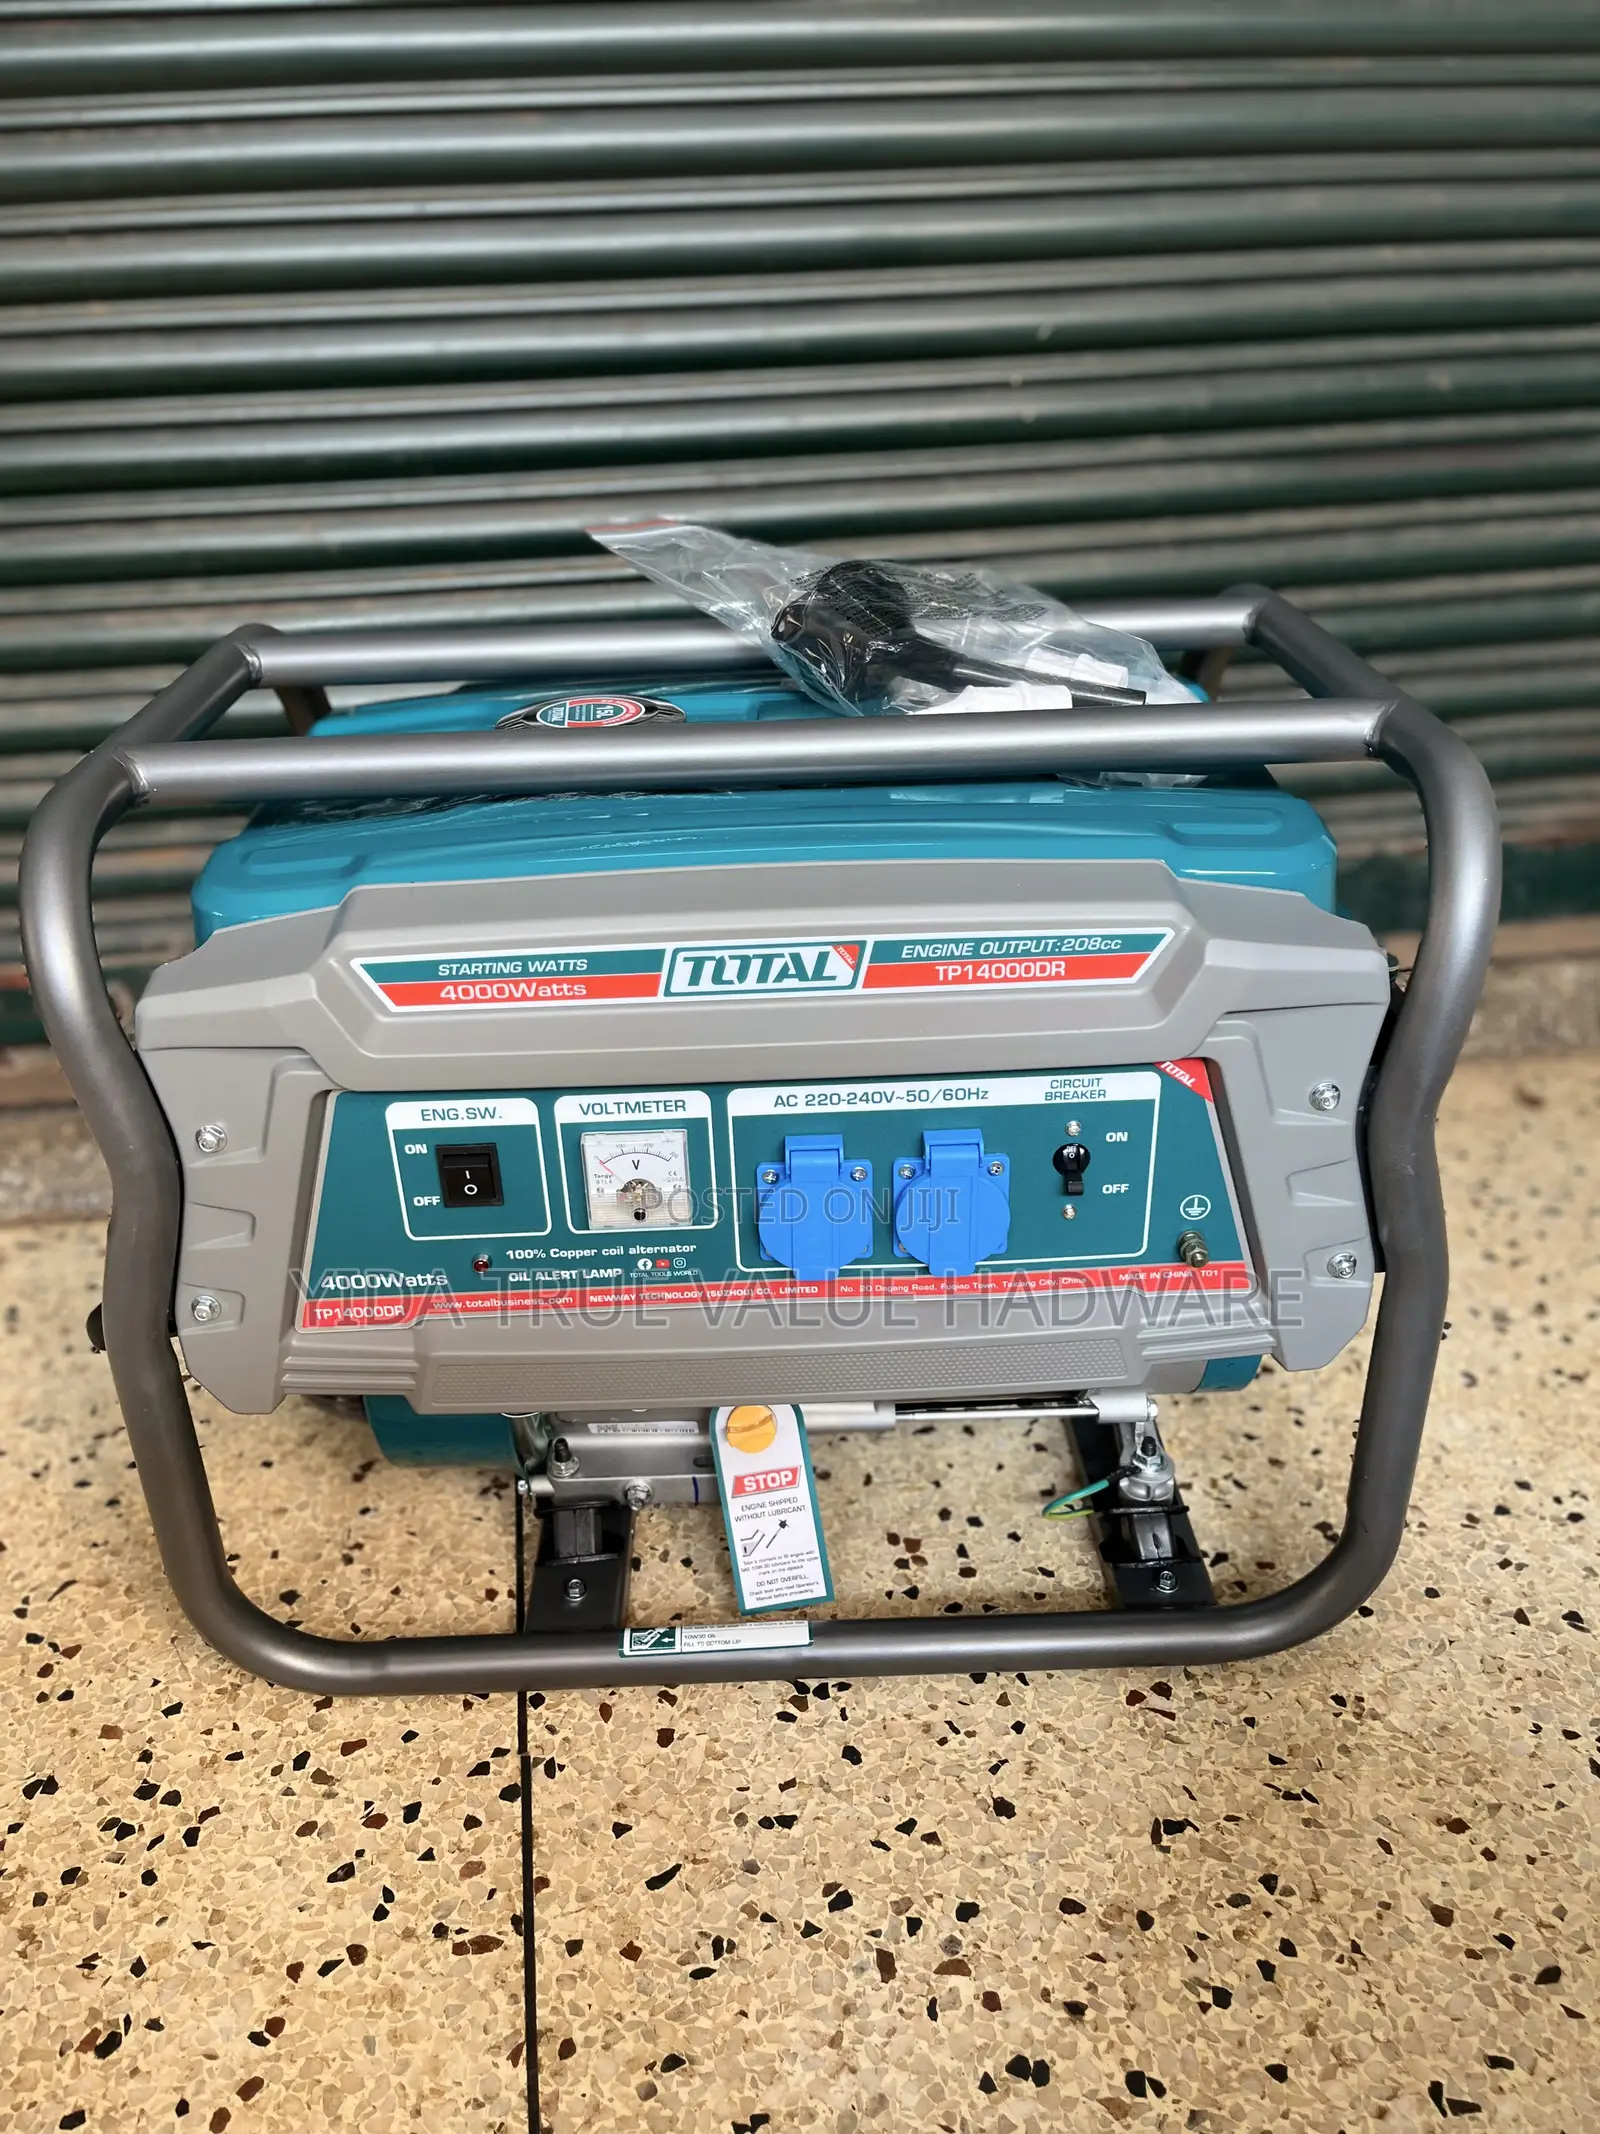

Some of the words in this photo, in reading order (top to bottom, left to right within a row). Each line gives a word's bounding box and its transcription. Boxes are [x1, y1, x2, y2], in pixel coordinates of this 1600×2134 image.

[901, 941, 974, 959] ENGINE
[980, 936, 1122, 956] OUTPUT:208cc
[438, 960, 523, 977] STARTING
[528, 958, 588, 972] WATTS
[682, 949, 837, 988] TOTAL
[935, 961, 1066, 982] TP14000DR
[440, 982, 588, 1001] 4000Watts
[1160, 1060, 1197, 1088] TOTAL
[1050, 1077, 1104, 1090] CIRCUIT
[773, 1093, 799, 1109] AC
[1044, 1089, 1107, 1101] BREAKER
[420, 1106, 503, 1122] ENG.SW.
[579, 1099, 687, 1116] VOLTMETER
[1105, 1131, 1129, 1142] ON
[404, 1143, 428, 1155] ON
[1066, 1145, 1077, 1153] OFF
[631, 1159, 640, 1170] V
[1101, 1183, 1130, 1194] OFF
[413, 1195, 441, 1207] OFF
[505, 1249, 547, 1260] 100%
[550, 1248, 597, 1260] Copper
[601, 1245, 624, 1256] coil
[628, 1244, 697, 1255] alternator
[508, 1271, 531, 1282] OIL
[535, 1269, 578, 1281] ALERT
[582, 1268, 623, 1279] LAMP
[651, 1270, 672, 1278] TOOLS
[673, 1268, 699, 1277] WORLD
[1118, 1272, 1147, 1281] MADE
[1150, 1271, 1161, 1280] IN
[1162, 1270, 1194, 1280] CHINA
[321, 1272, 448, 1291] 4000Watts
[840, 1284, 856, 1294] No.
[859, 1283, 873, 1293] 20
[940, 1281, 970, 1293] Fuqiao
[589, 1294, 636, 1304] NEWWAY
[639, 1290, 704, 1301] TECHNOLOGY
[706, 1287, 754, 1299] (SUZHOU)
[779, 1285, 819, 1296] LIMITED
[433, 1295, 573, 1310] www.totalbusiness.com
[314, 1305, 406, 1321] TP14000DR
[743, 1469, 793, 1492] STOP
[740, 1501, 767, 1512] ENGINE
[768, 1496, 798, 1507] SHIPPED
[734, 1511, 766, 1523] WITHOUT
[767, 1577, 779, 1585] NOT
